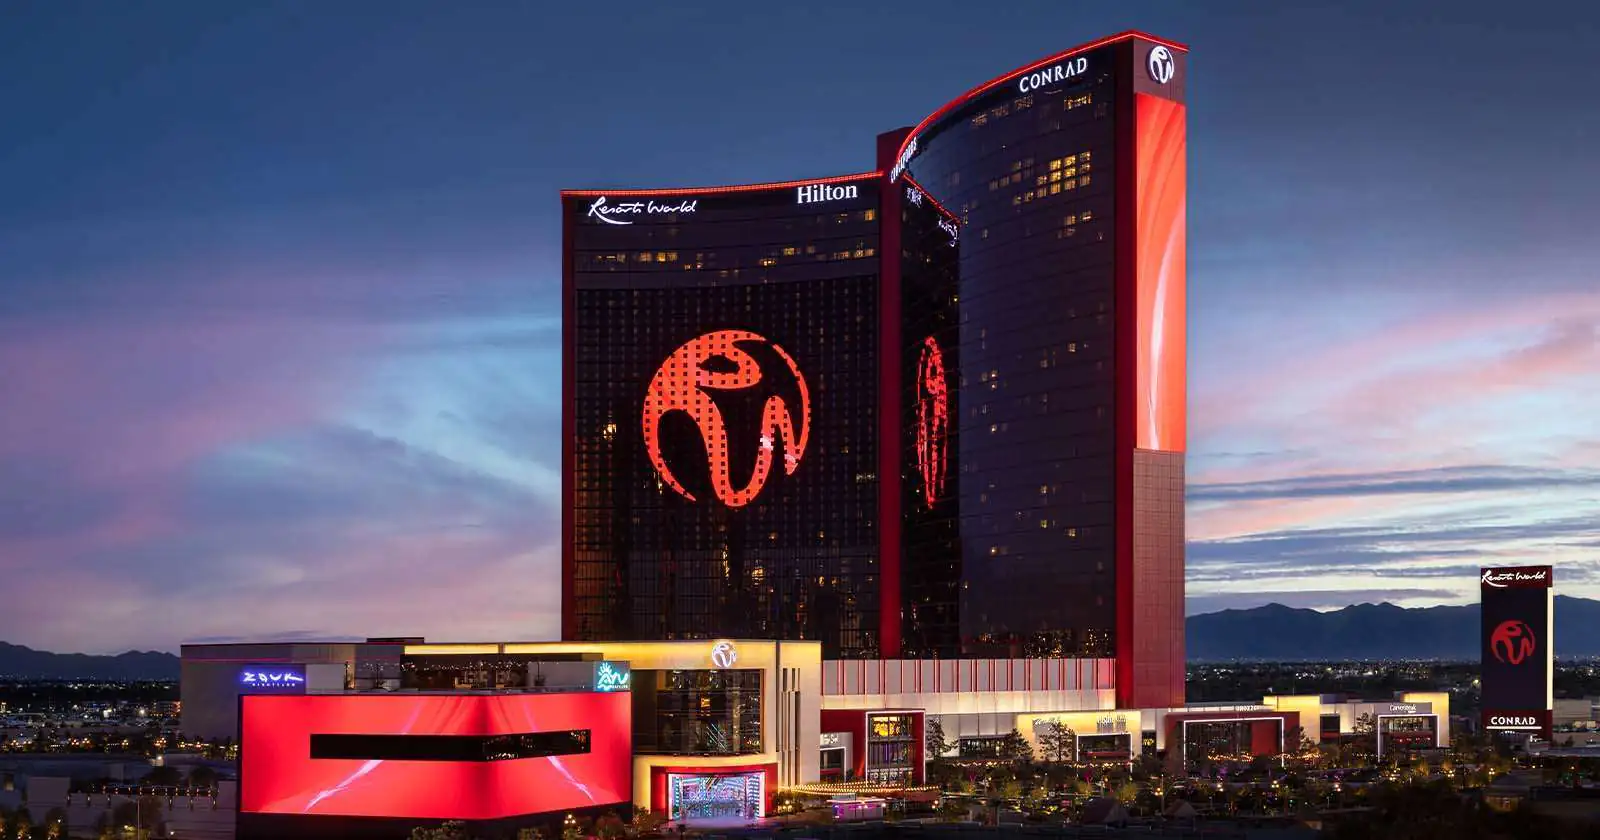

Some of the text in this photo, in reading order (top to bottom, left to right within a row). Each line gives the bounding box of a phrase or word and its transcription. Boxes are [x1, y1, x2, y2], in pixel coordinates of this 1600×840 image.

[1019, 57, 1087, 92] CONRAD
[797, 183, 858, 204] Hilton
[588, 196, 697, 225] Resorts World
[1490, 716, 1536, 725] CONRAD
